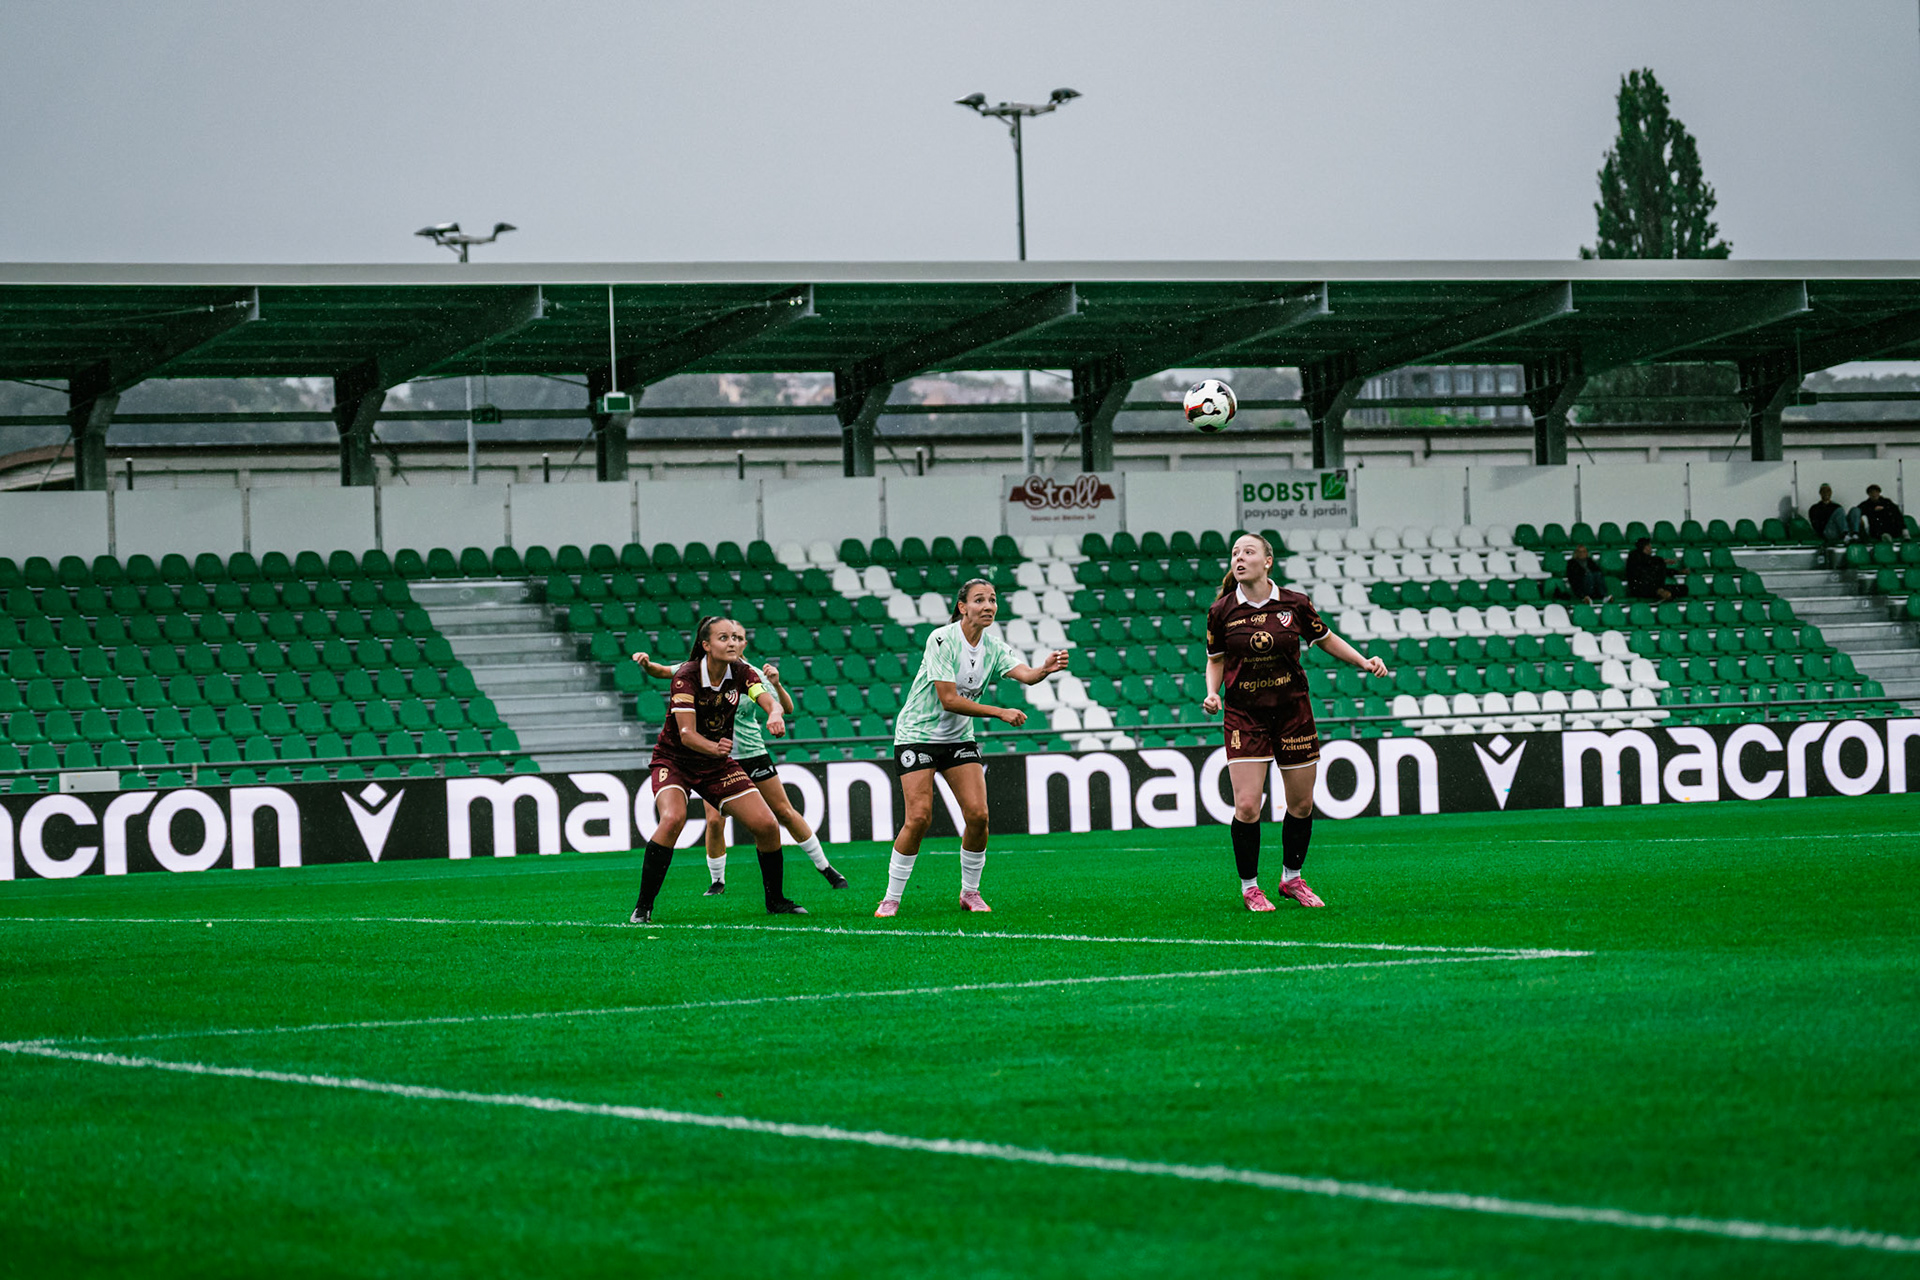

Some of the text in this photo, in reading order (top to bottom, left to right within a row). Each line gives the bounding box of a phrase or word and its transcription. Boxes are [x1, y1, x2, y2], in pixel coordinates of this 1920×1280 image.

[1024, 475, 1100, 509] Stoll
[1243, 482, 1317, 502] BOBST
[1244, 503, 1348, 519] paysage & jardin
[1238, 672, 1292, 693] regiobank
[1231, 730, 1241, 750] 4
[659, 767, 669, 782] 6
[0, 788, 302, 880] cron
